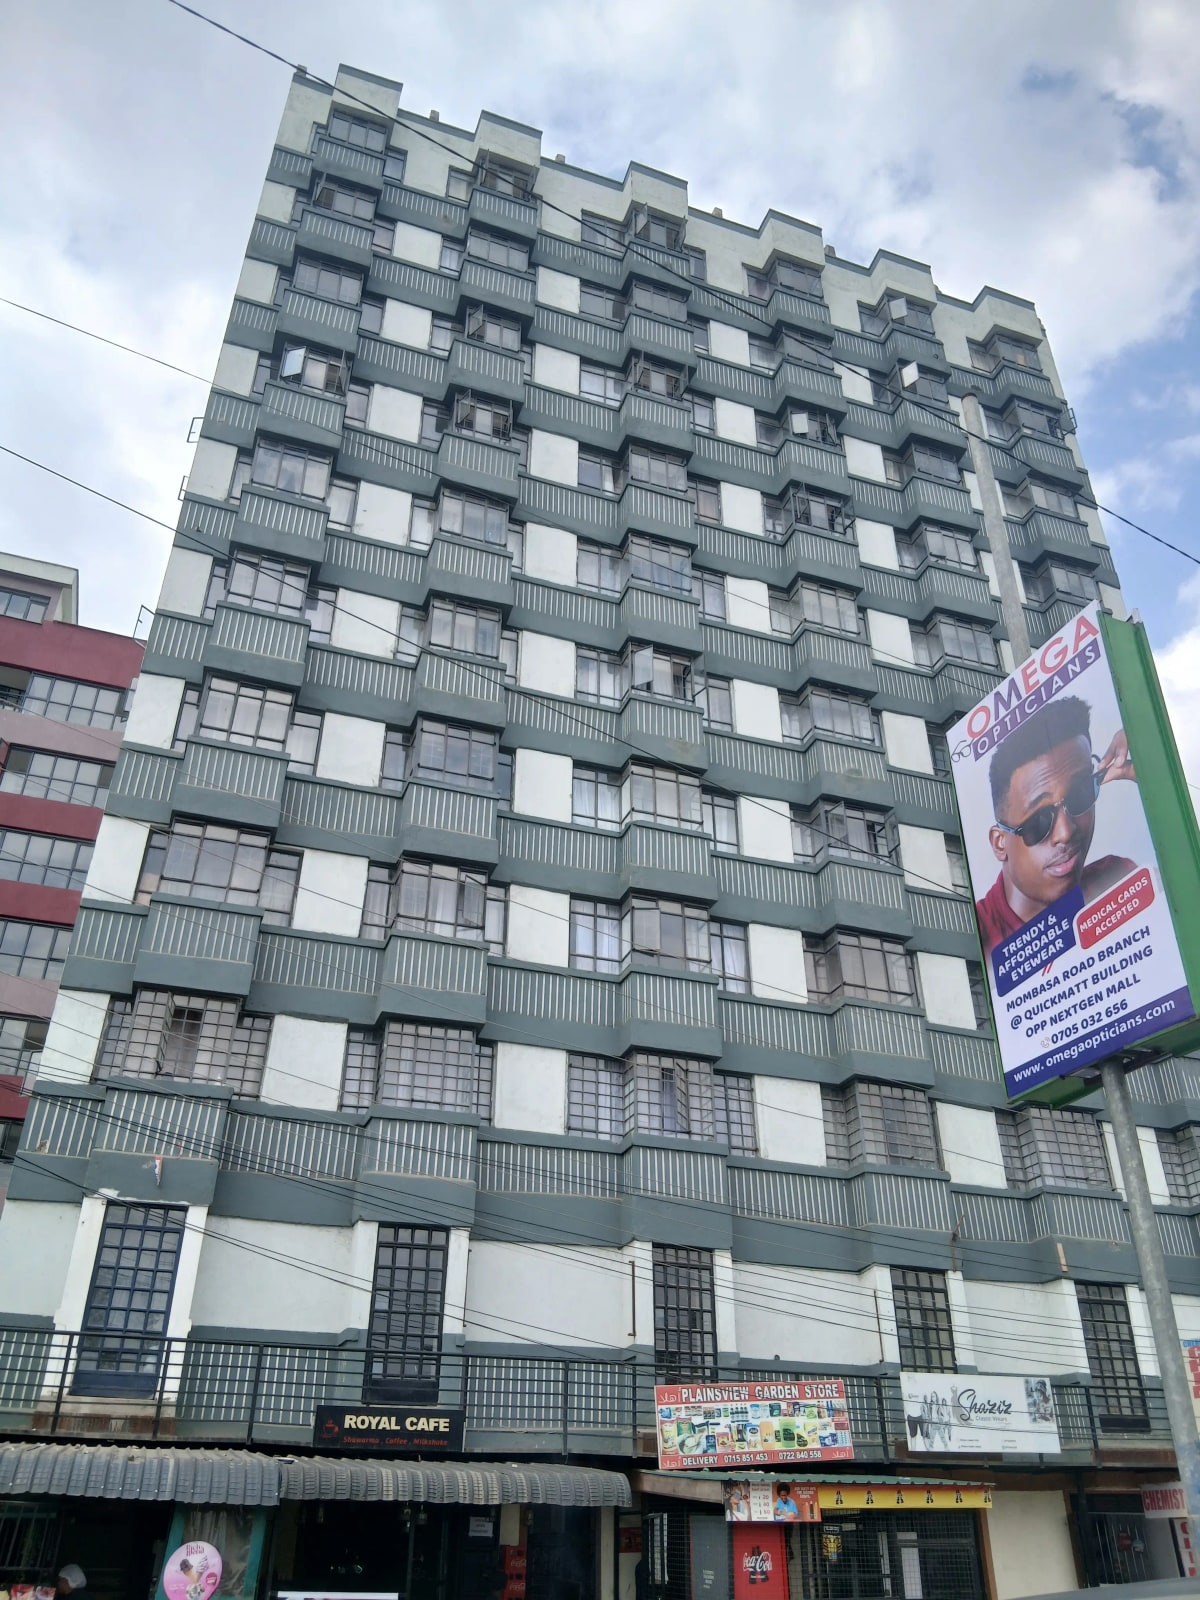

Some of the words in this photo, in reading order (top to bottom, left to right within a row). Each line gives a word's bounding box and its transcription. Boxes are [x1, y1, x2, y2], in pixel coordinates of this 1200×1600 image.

[967, 616, 1099, 738] OMEGA
[977, 646, 1096, 753] OPTICIANS
[1079, 902, 1117, 932] MEDICAL
[1118, 877, 1148, 903] CARDS
[1095, 899, 1140, 936] ACCEPTED
[998, 919, 1070, 976] AFFORDABLE
[1002, 920, 1044, 957] TRENDY
[1048, 914, 1057, 924] &
[1011, 938, 1064, 982] EYEWEAR
[1006, 976, 1061, 1012] MOMBASA
[1062, 957, 1095, 981] ROAD
[1098, 926, 1150, 962] BRANCH
[1011, 1015, 1022, 1029] @
[1025, 979, 1089, 1019] QUICKMATT
[1092, 945, 1153, 985] BUILDING
[1026, 1021, 1047, 1037] OPP
[1050, 994, 1104, 1026] NEXTGEN
[1106, 973, 1141, 997] MALL
[1051, 1024, 1079, 1044] 0705
[1081, 1012, 1103, 1030] 032
[1105, 999, 1128, 1018] 656
[1014, 1065, 1044, 1082] www.
[1046, 999, 1175, 1067] omegaopticians.com
[682, 1386, 749, 1402] PLAINSVIEW
[755, 1385, 799, 1399] GARDEN
[804, 1384, 839, 1397] STORE
[344, 1414, 400, 1430] ROYAL
[405, 1417, 450, 1432] CAFE
[682, 1456, 719, 1466] DELIVERY
[724, 1455, 740, 1463] 0715
[779, 1452, 795, 1460] 0722
[1142, 1489, 1186, 1512] CHEMIST
